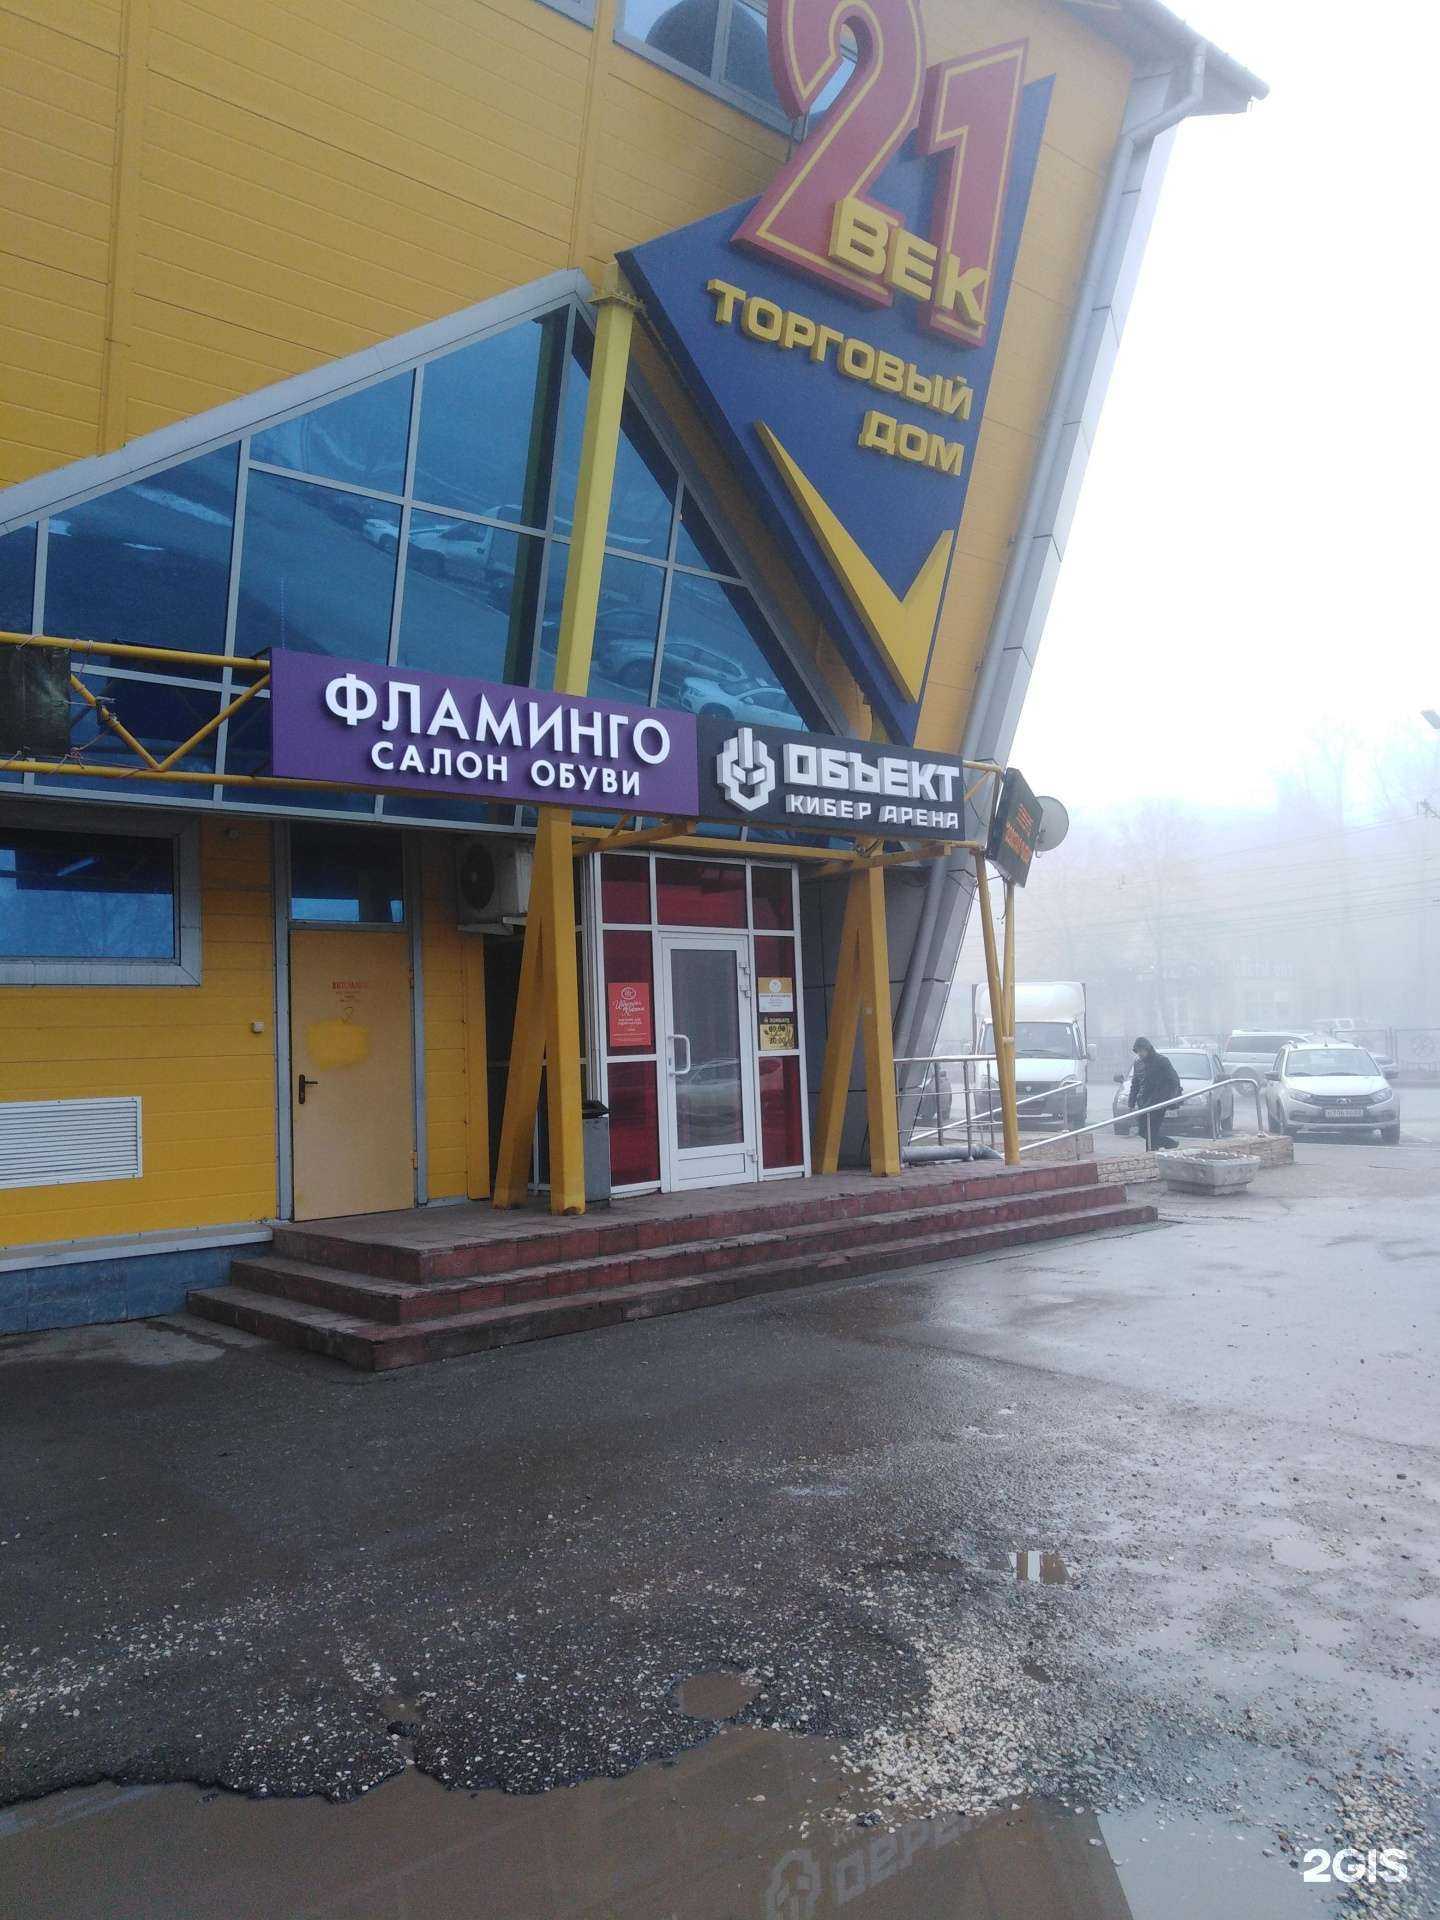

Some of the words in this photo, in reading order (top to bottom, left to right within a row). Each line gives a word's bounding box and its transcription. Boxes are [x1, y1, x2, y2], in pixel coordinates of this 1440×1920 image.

[730, 0, 1028, 347] 21
[828, 197, 990, 326] ВЕК
[707, 278, 973, 420] ТОРГОВЫЙ
[858, 409, 966, 476] ДОМ
[325, 673, 671, 765] ФЛАМИНГО
[371, 741, 508, 782] САЛОН
[530, 760, 640, 796] ОБУВИ
[783, 743, 959, 802] ОБЪЕКТ
[785, 794, 871, 820] КИБЕР
[879, 805, 959, 829] АРЕНА
